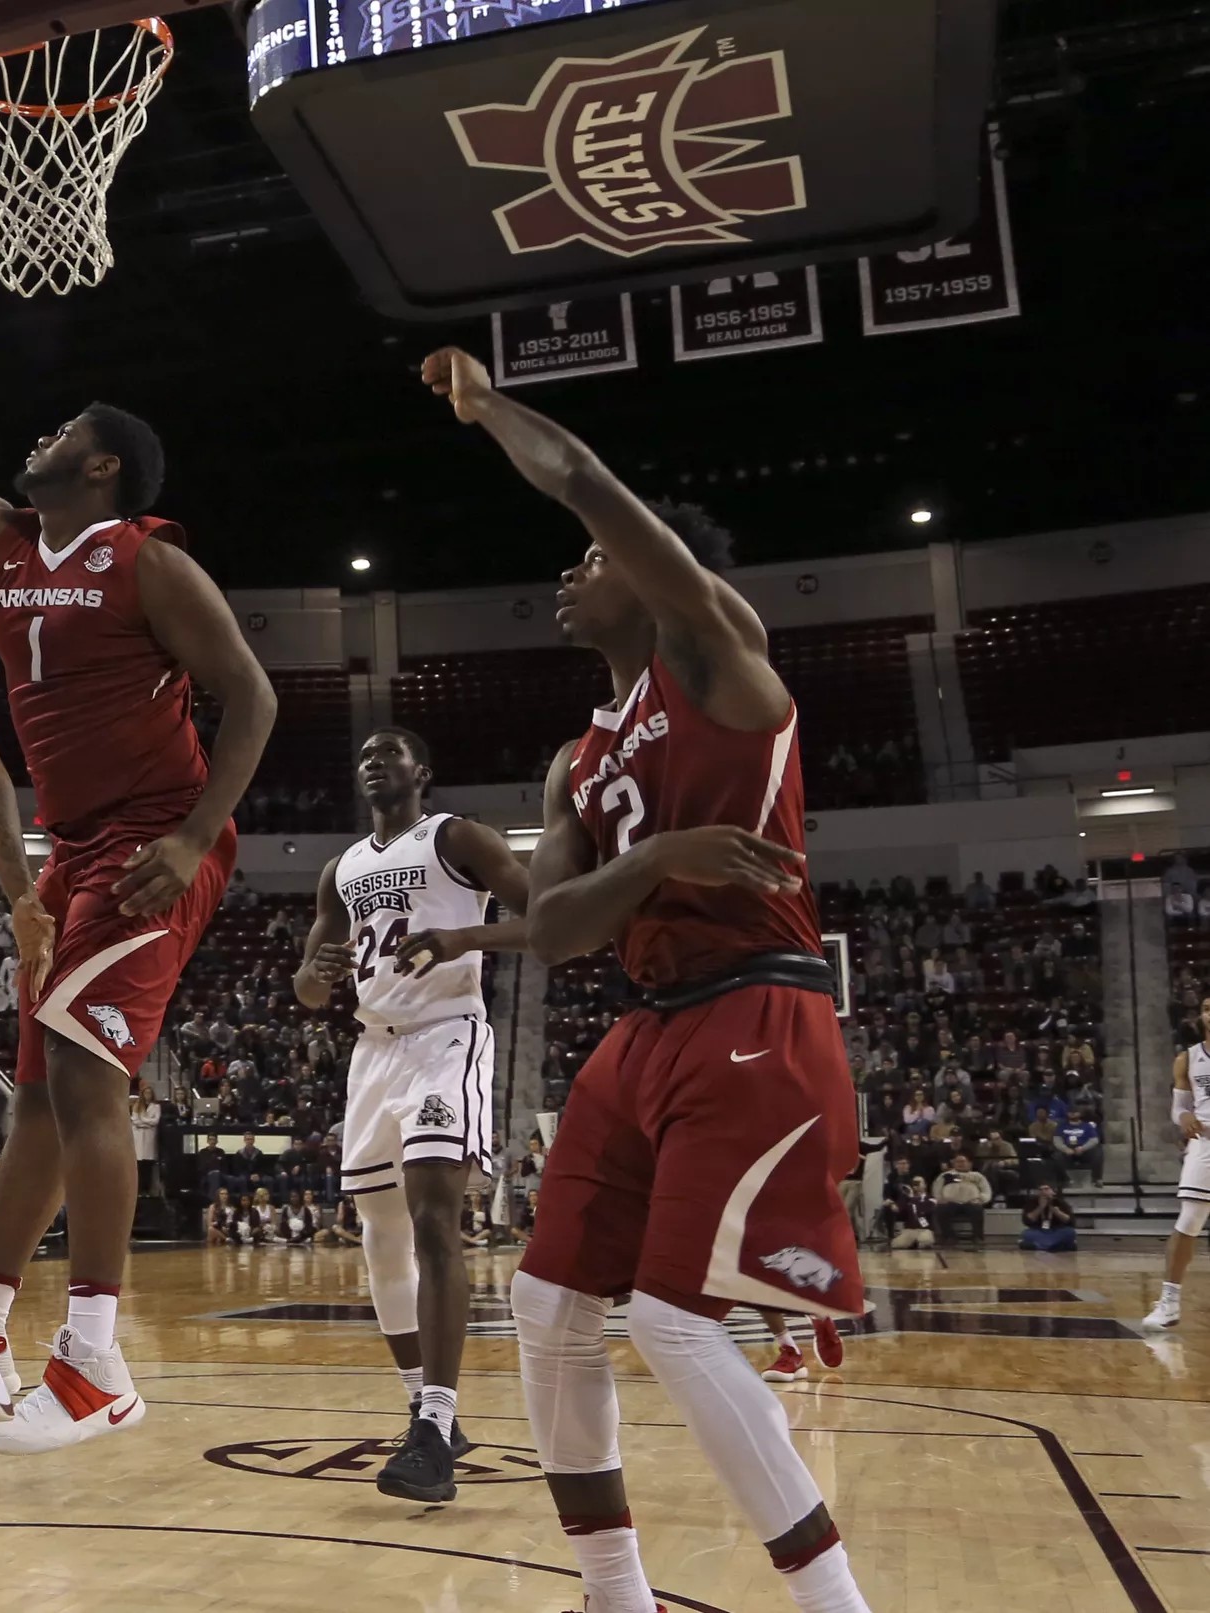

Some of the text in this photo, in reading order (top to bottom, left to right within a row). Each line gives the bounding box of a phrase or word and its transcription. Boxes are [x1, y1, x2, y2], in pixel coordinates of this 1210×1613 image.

[329, 10, 339, 22] 2
[472, 5, 489, 18] FT
[326, 37, 344, 50] 11
[372, 28, 382, 41] 2
[411, 20, 421, 33] 2
[330, 23, 340, 36] 3
[327, 50, 347, 65] 24
[412, 34, 422, 47] 2
[573, 91, 686, 223] STATE
[885, 275, 993, 303] 1957-1959
[695, 301, 796, 330] 1956-1965
[518, 330, 609, 356] 1953-2011
[707, 322, 787, 343] HEAD COACH
[510, 358, 546, 371] VOICE
[558, 347, 619, 364] BULLDOGS
[28, 616, 44, 681] 1
[341, 869, 427, 903] MISSISSIPPI
[364, 893, 400, 915] STATE
